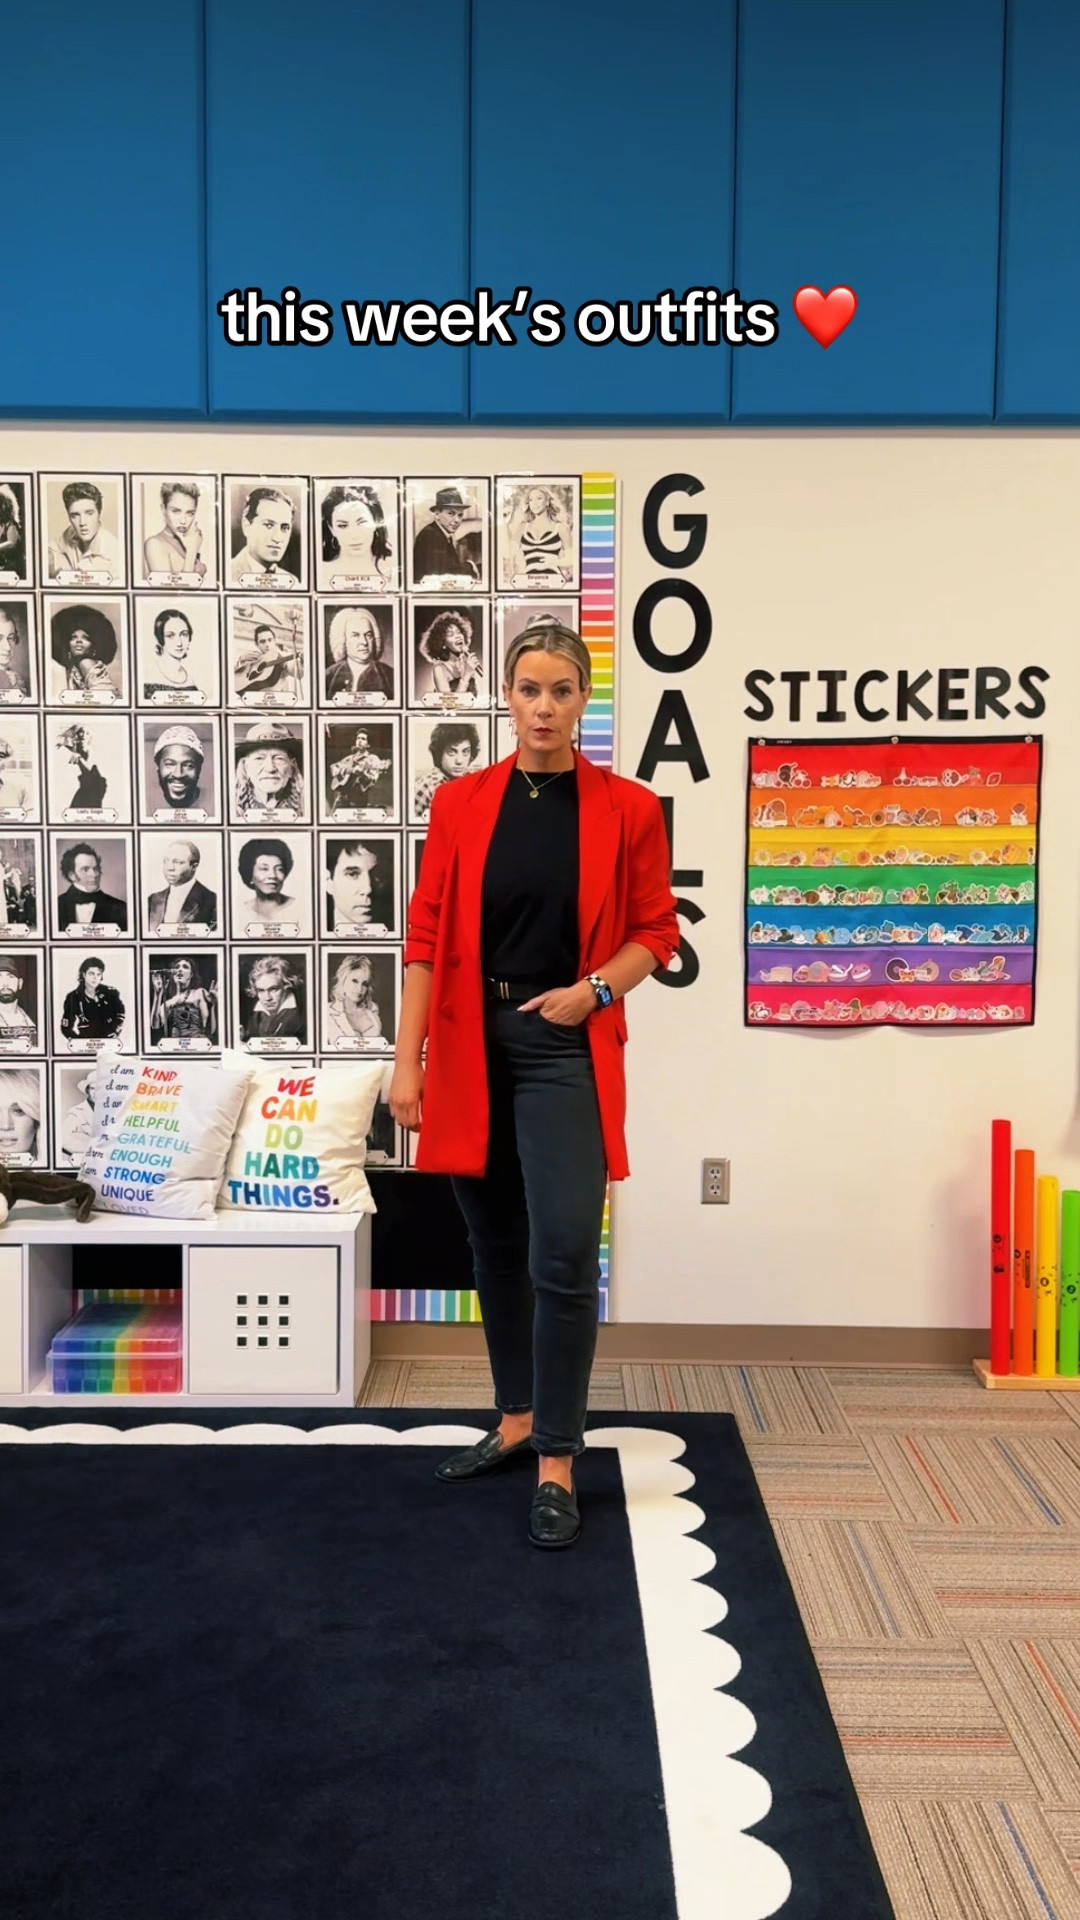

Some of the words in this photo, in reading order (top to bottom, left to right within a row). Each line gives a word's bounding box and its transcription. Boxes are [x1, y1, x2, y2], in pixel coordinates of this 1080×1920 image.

[743, 665, 1051, 723] STICKERS
[632, 473, 713, 988] GOALS
[142, 1066, 178, 1082] KIND
[136, 1082, 184, 1097] BRAVE
[277, 1076, 316, 1097] WE
[131, 1099, 179, 1113] SMART
[261, 1096, 318, 1123] CAN
[123, 1115, 181, 1133] HELPFUL
[117, 1132, 192, 1155] GRATEFUL
[264, 1123, 304, 1150] DO
[109, 1149, 173, 1169] ENOUGH
[244, 1151, 320, 1180] HARD
[104, 1166, 167, 1185] STRONG
[101, 1183, 155, 1202] UNIQUE
[228, 1180, 340, 1208] THINGS.
